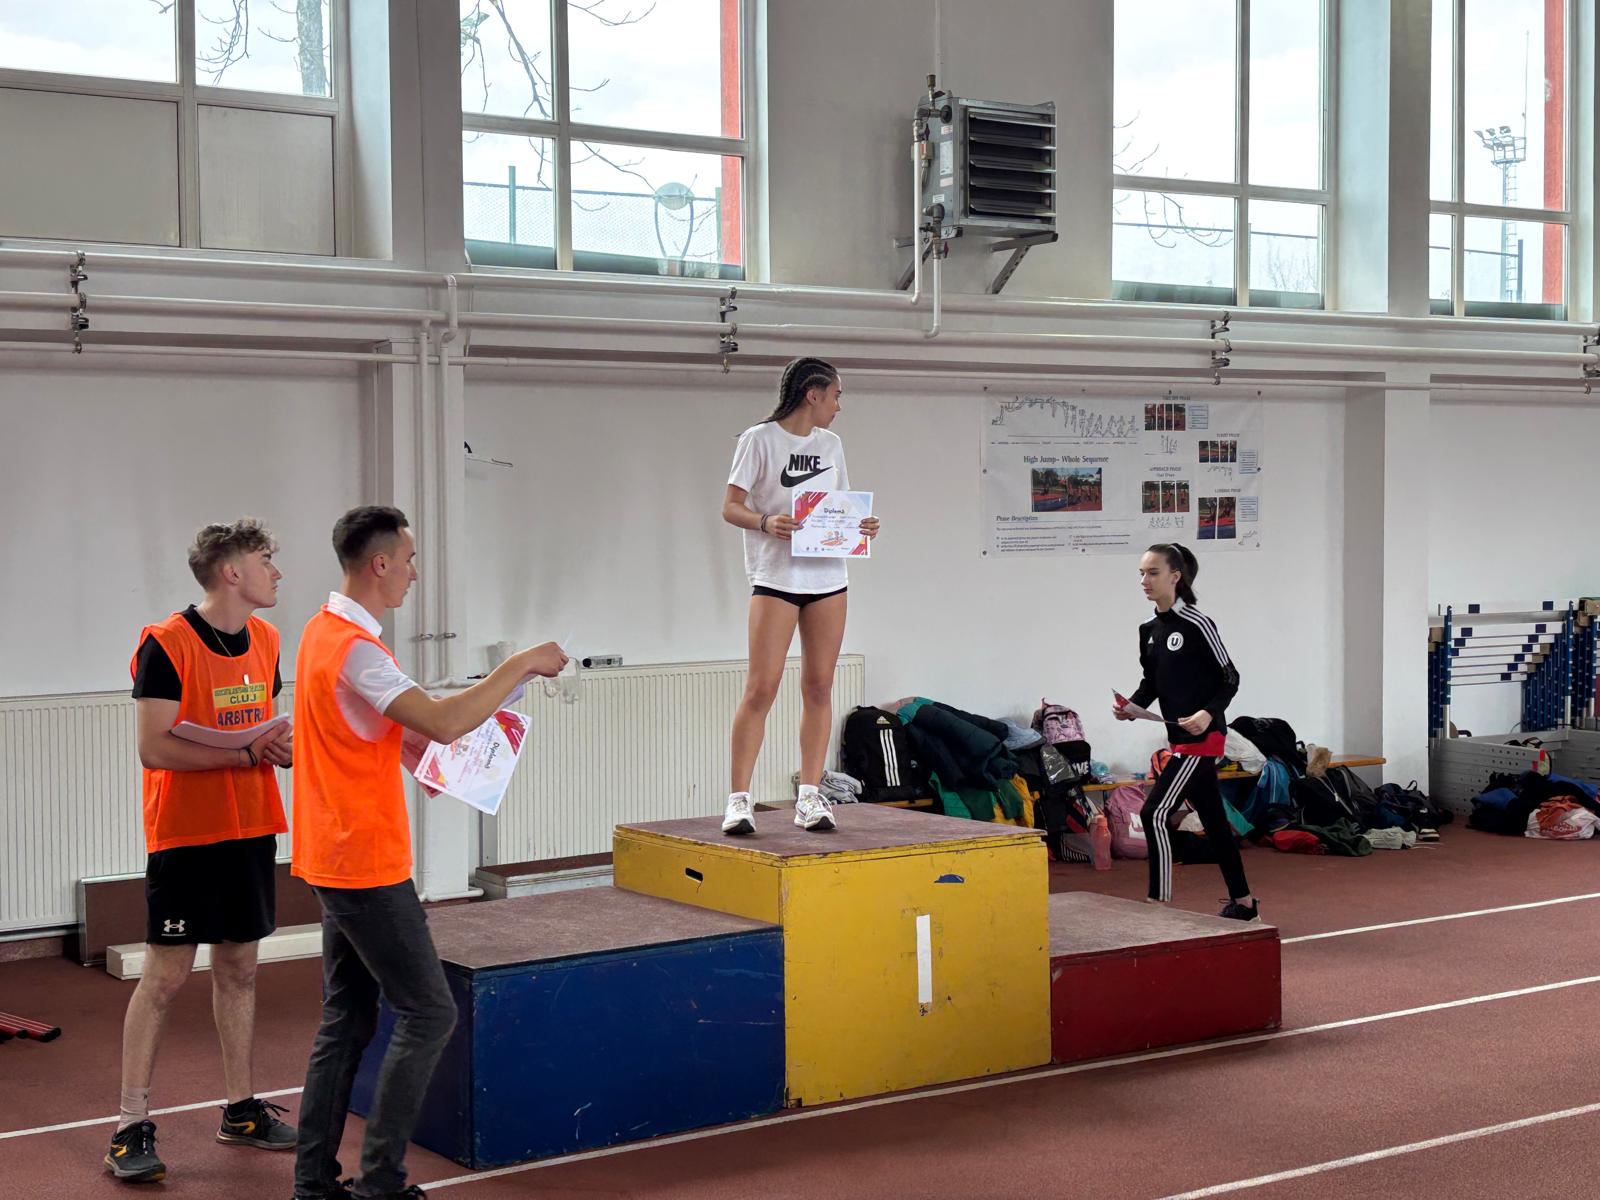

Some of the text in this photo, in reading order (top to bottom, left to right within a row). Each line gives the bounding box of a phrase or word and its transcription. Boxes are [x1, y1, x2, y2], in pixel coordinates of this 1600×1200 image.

[788, 453, 821, 472] NIKE
[1023, 455, 1038, 464] High
[1061, 455, 1080, 463] Whole
[1082, 456, 1109, 465] Sequence
[230, 694, 257, 704] CLUJ
